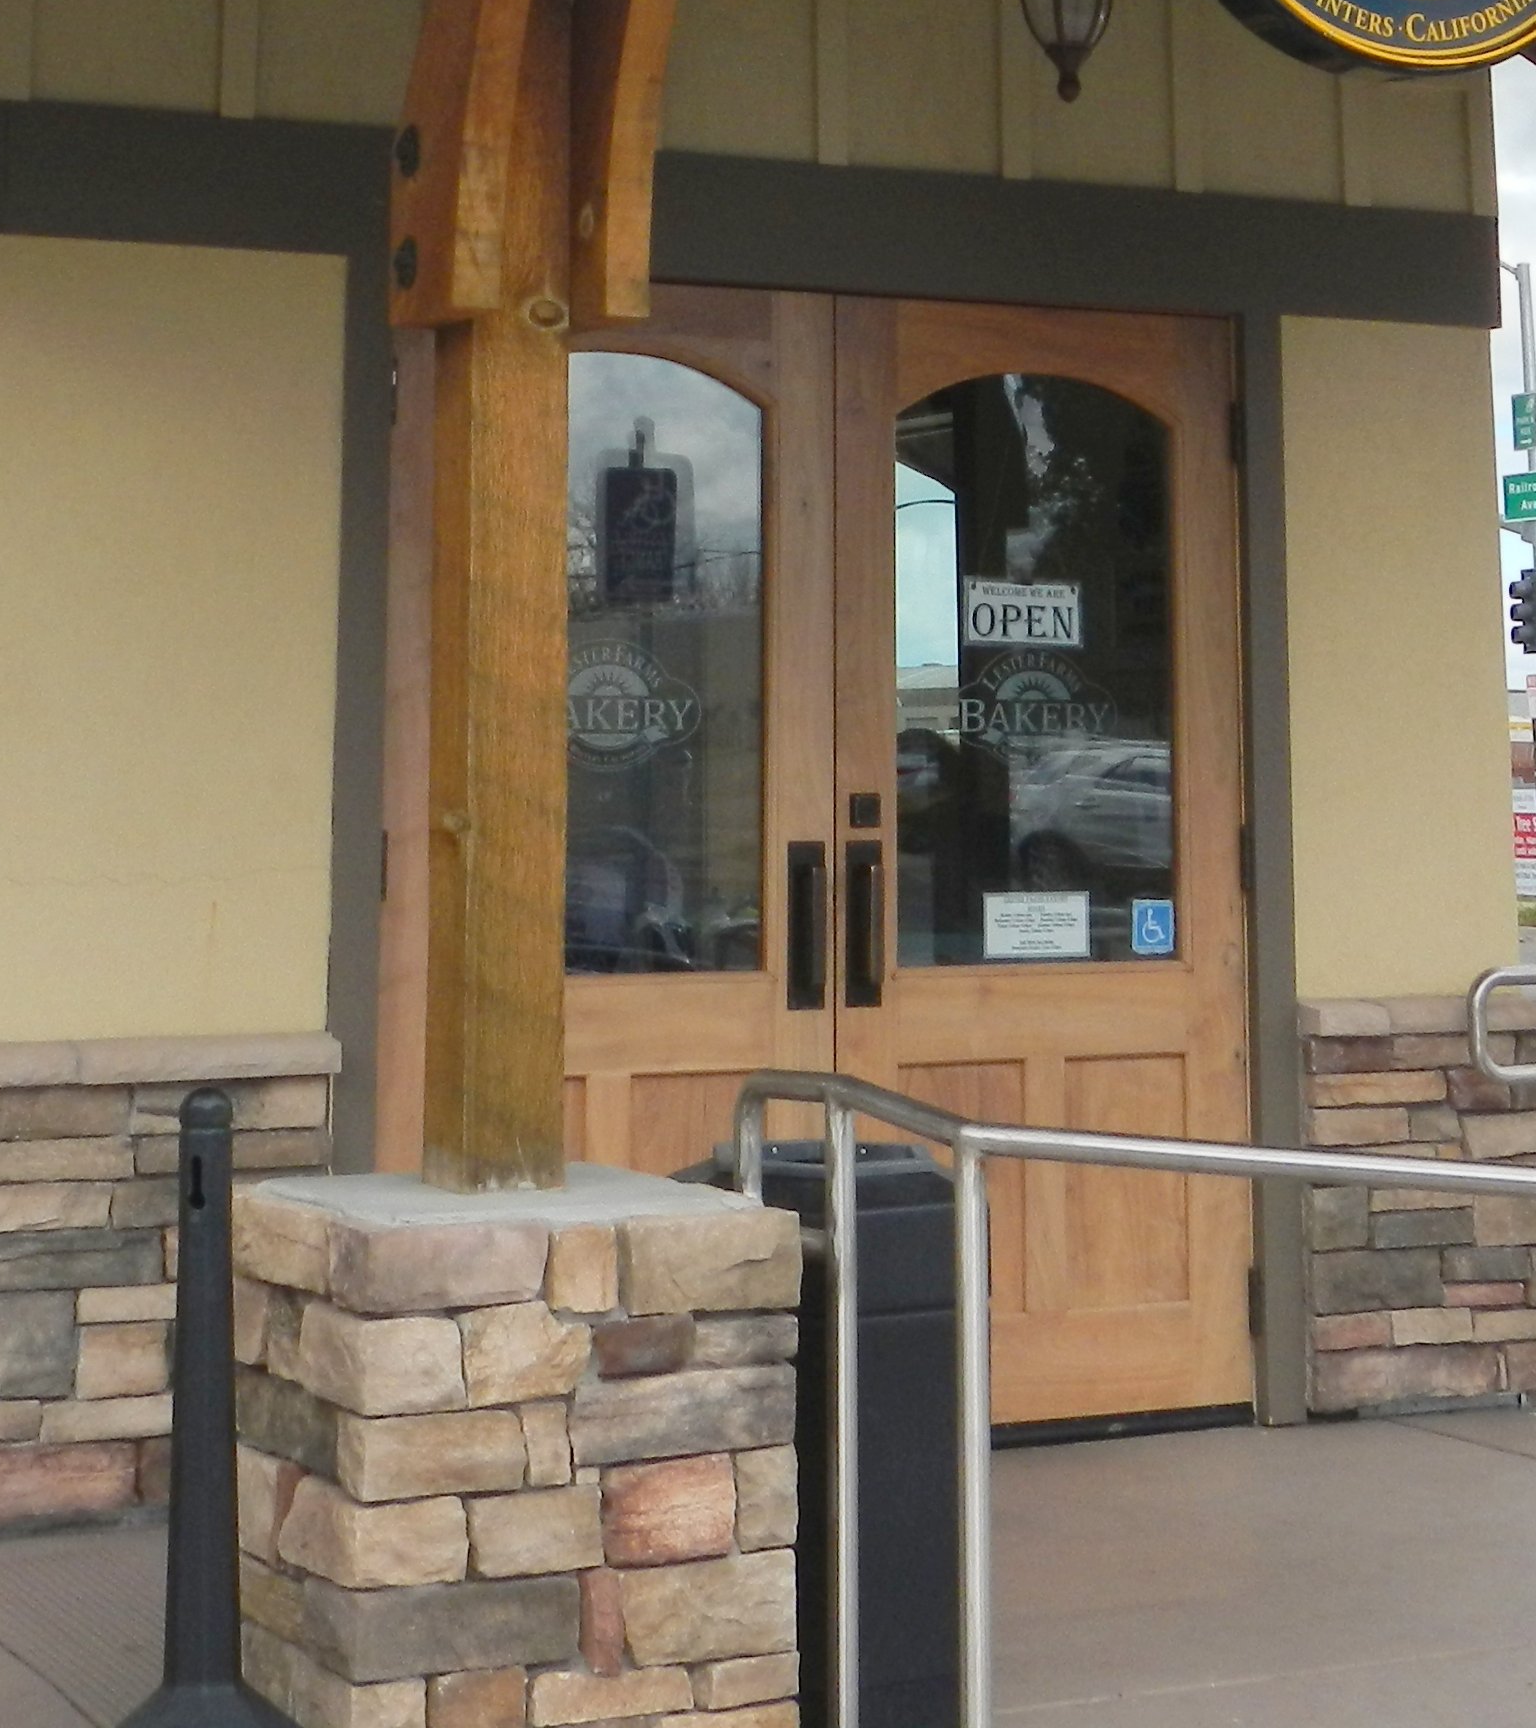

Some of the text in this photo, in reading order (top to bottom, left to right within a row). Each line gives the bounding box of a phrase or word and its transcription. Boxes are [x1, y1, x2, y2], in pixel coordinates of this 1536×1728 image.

[972, 602, 1073, 639] OPEN
[568, 698, 694, 732] AKERY
[959, 698, 1110, 733] BAKERY
